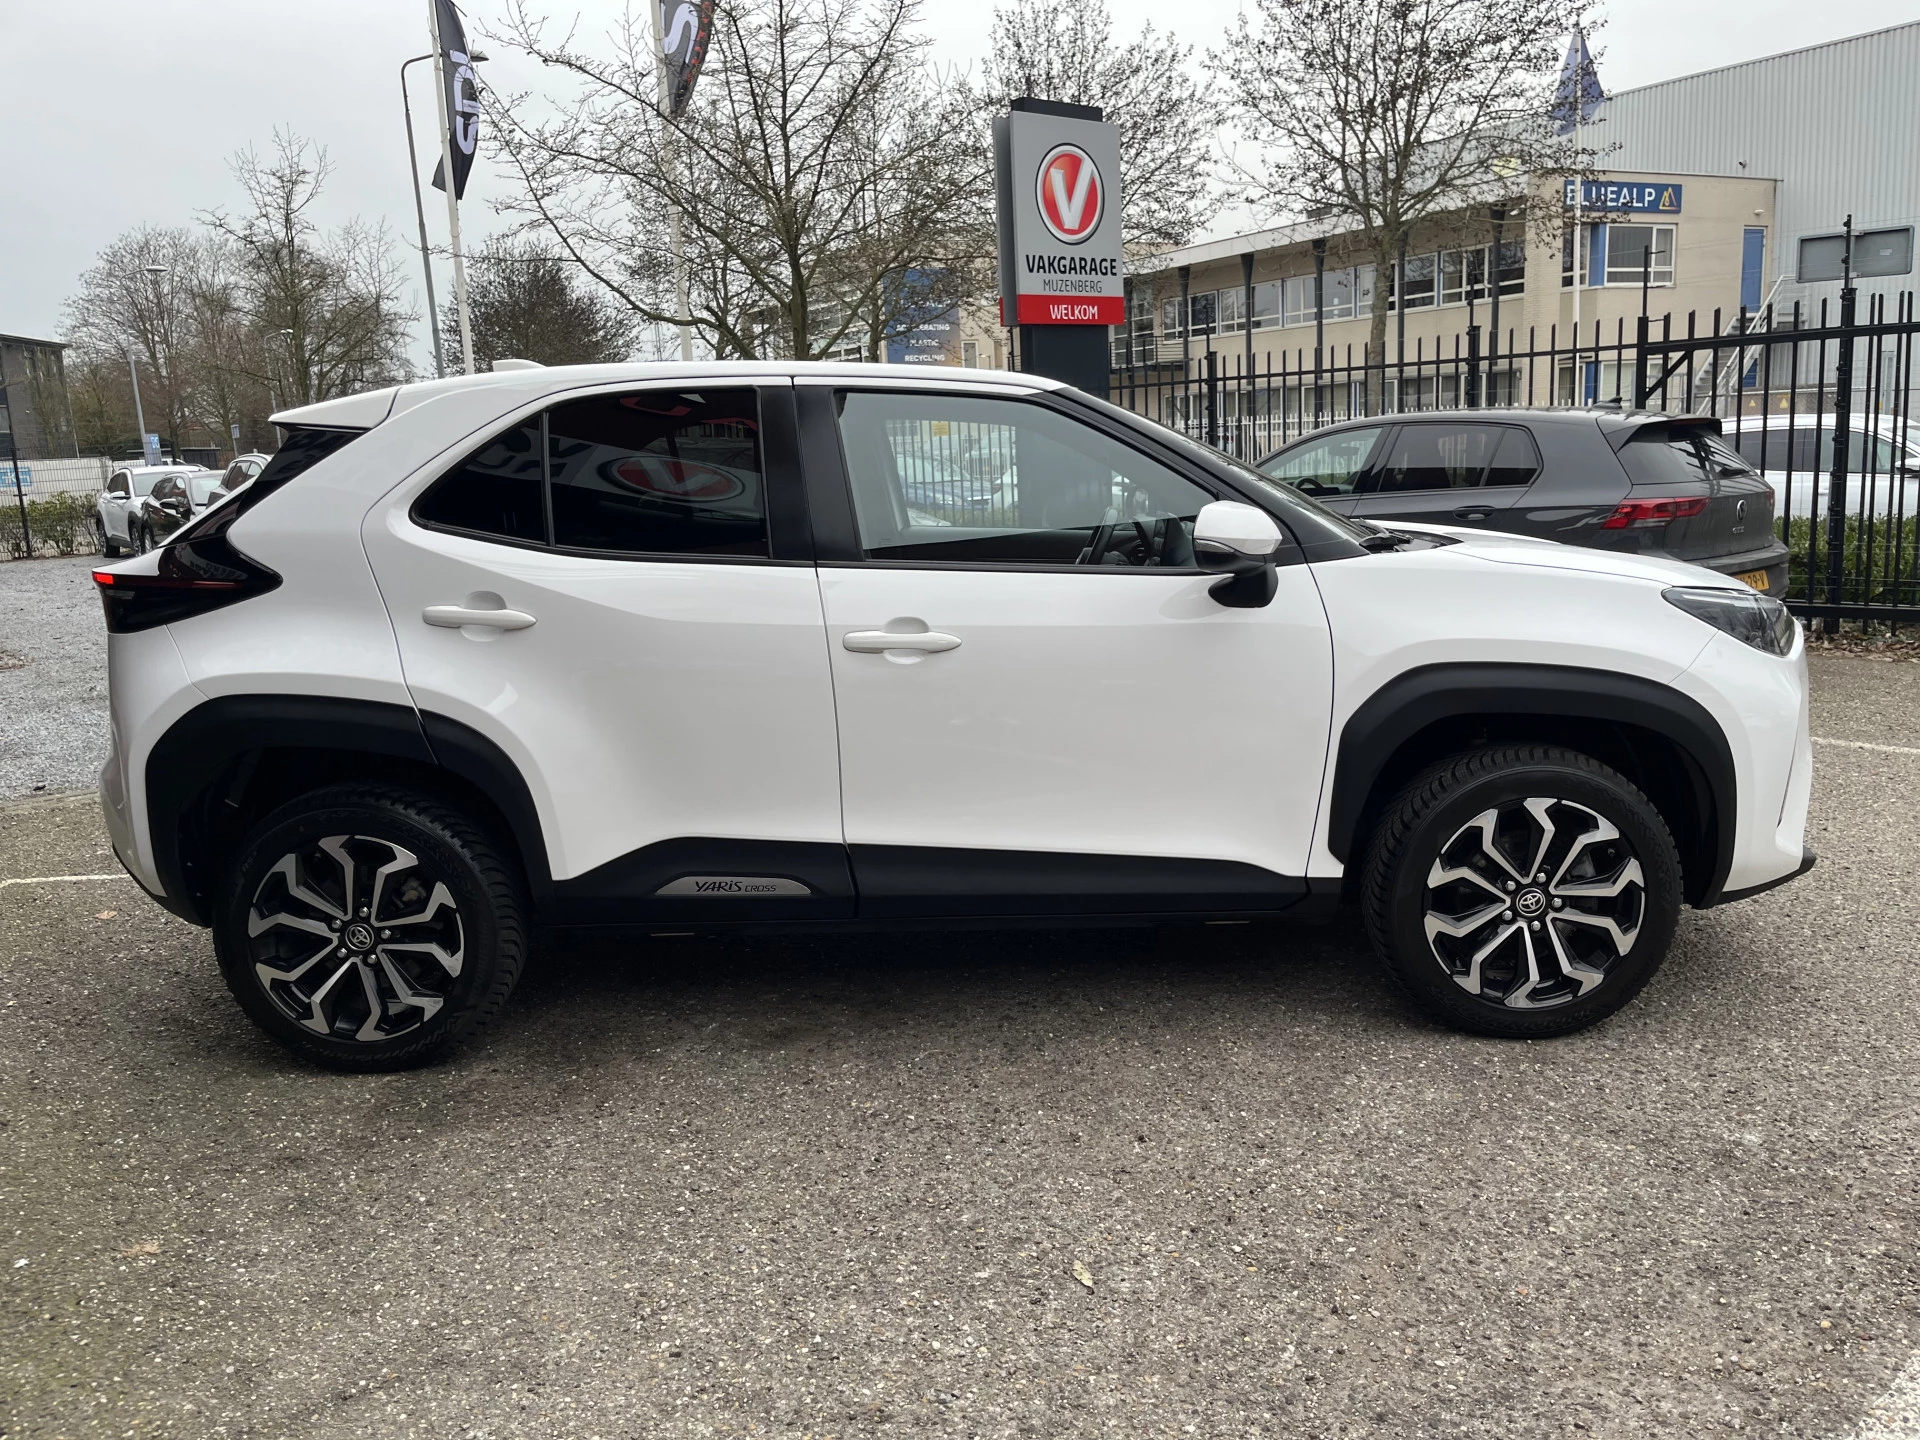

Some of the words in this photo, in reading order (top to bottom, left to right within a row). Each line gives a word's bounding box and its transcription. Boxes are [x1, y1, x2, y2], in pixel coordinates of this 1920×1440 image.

[1050, 155, 1094, 231] V
[1026, 254, 1117, 276] VAKGARAGE
[1043, 279, 1103, 293] MUZENBERG
[1049, 304, 1099, 320] WELKOM
[745, 885, 777, 893] CROSS
